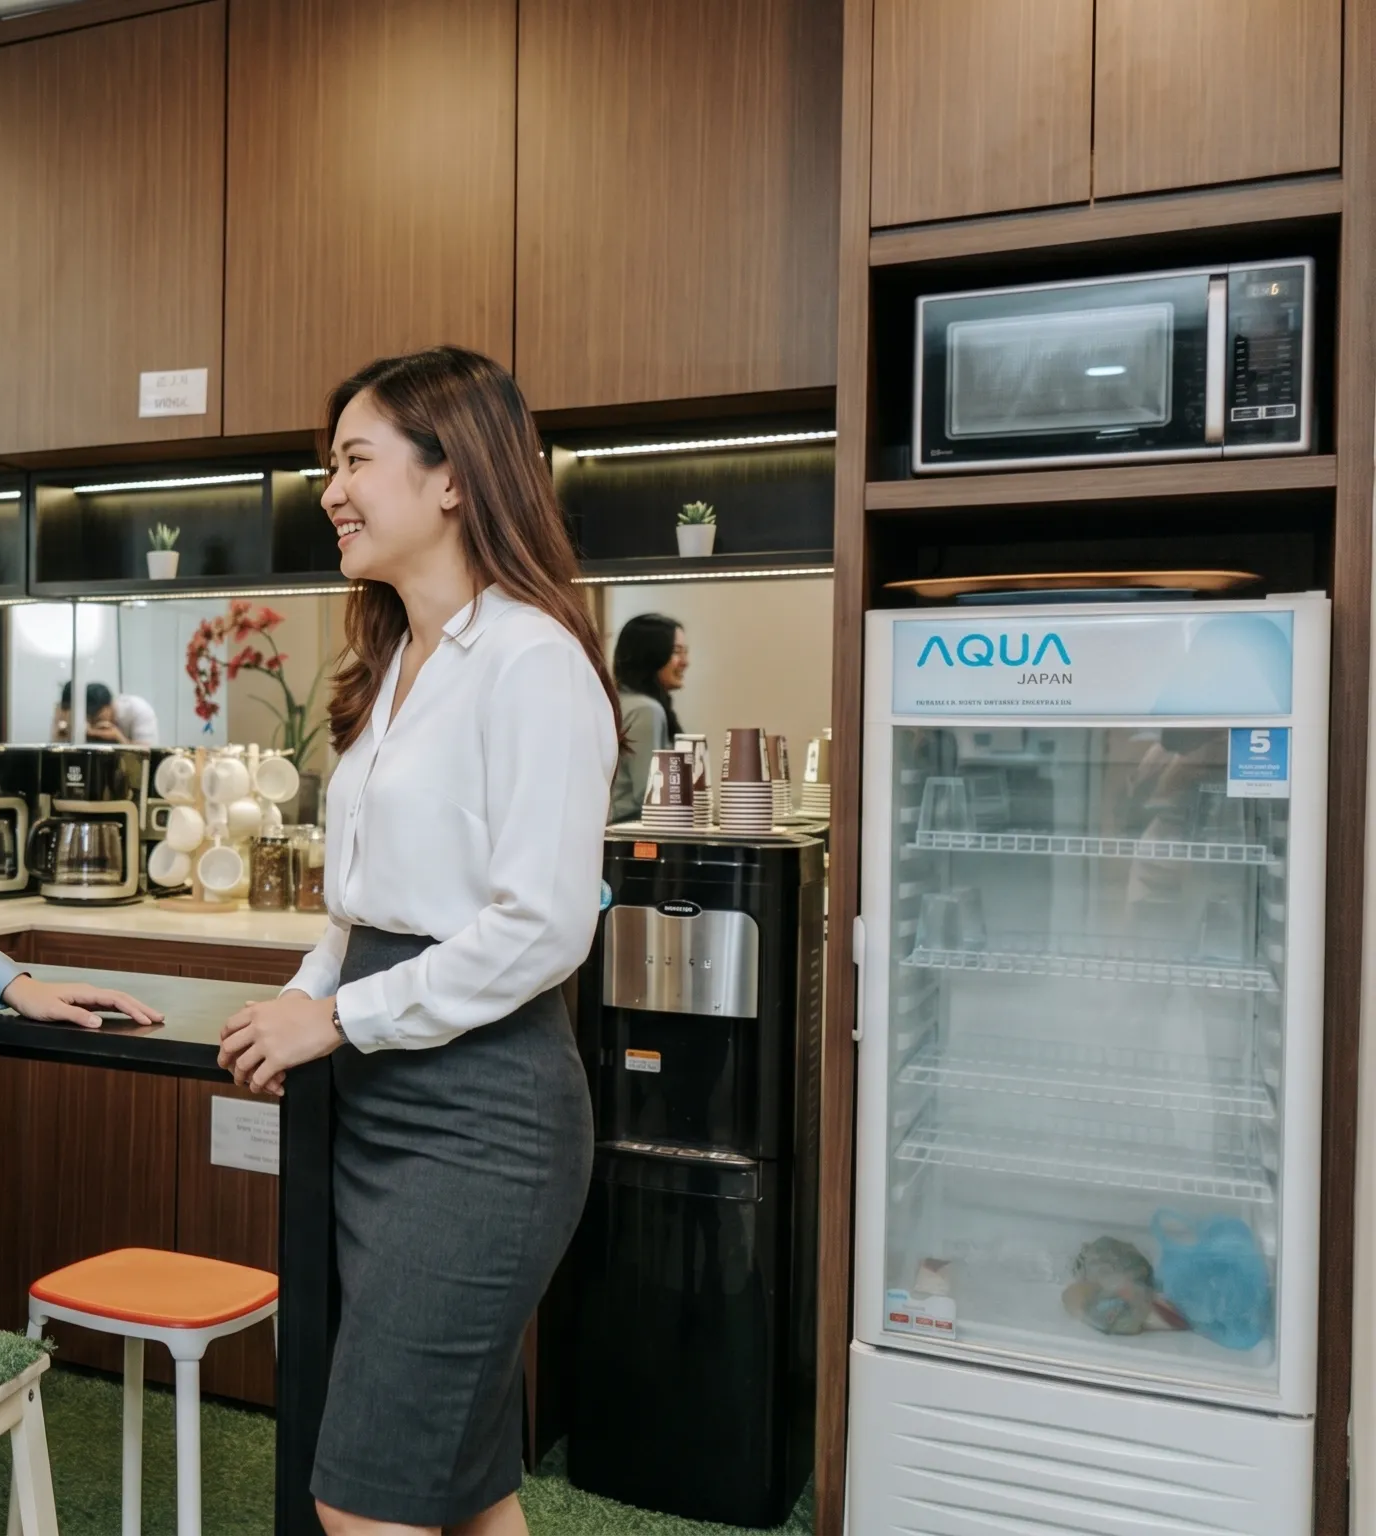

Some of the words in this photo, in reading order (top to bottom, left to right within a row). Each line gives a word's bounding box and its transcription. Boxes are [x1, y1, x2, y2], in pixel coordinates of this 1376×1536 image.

[916, 632, 1072, 668] AQUA
[1017, 673, 1073, 685] JAPAN
[1249, 729, 1271, 754] 5
